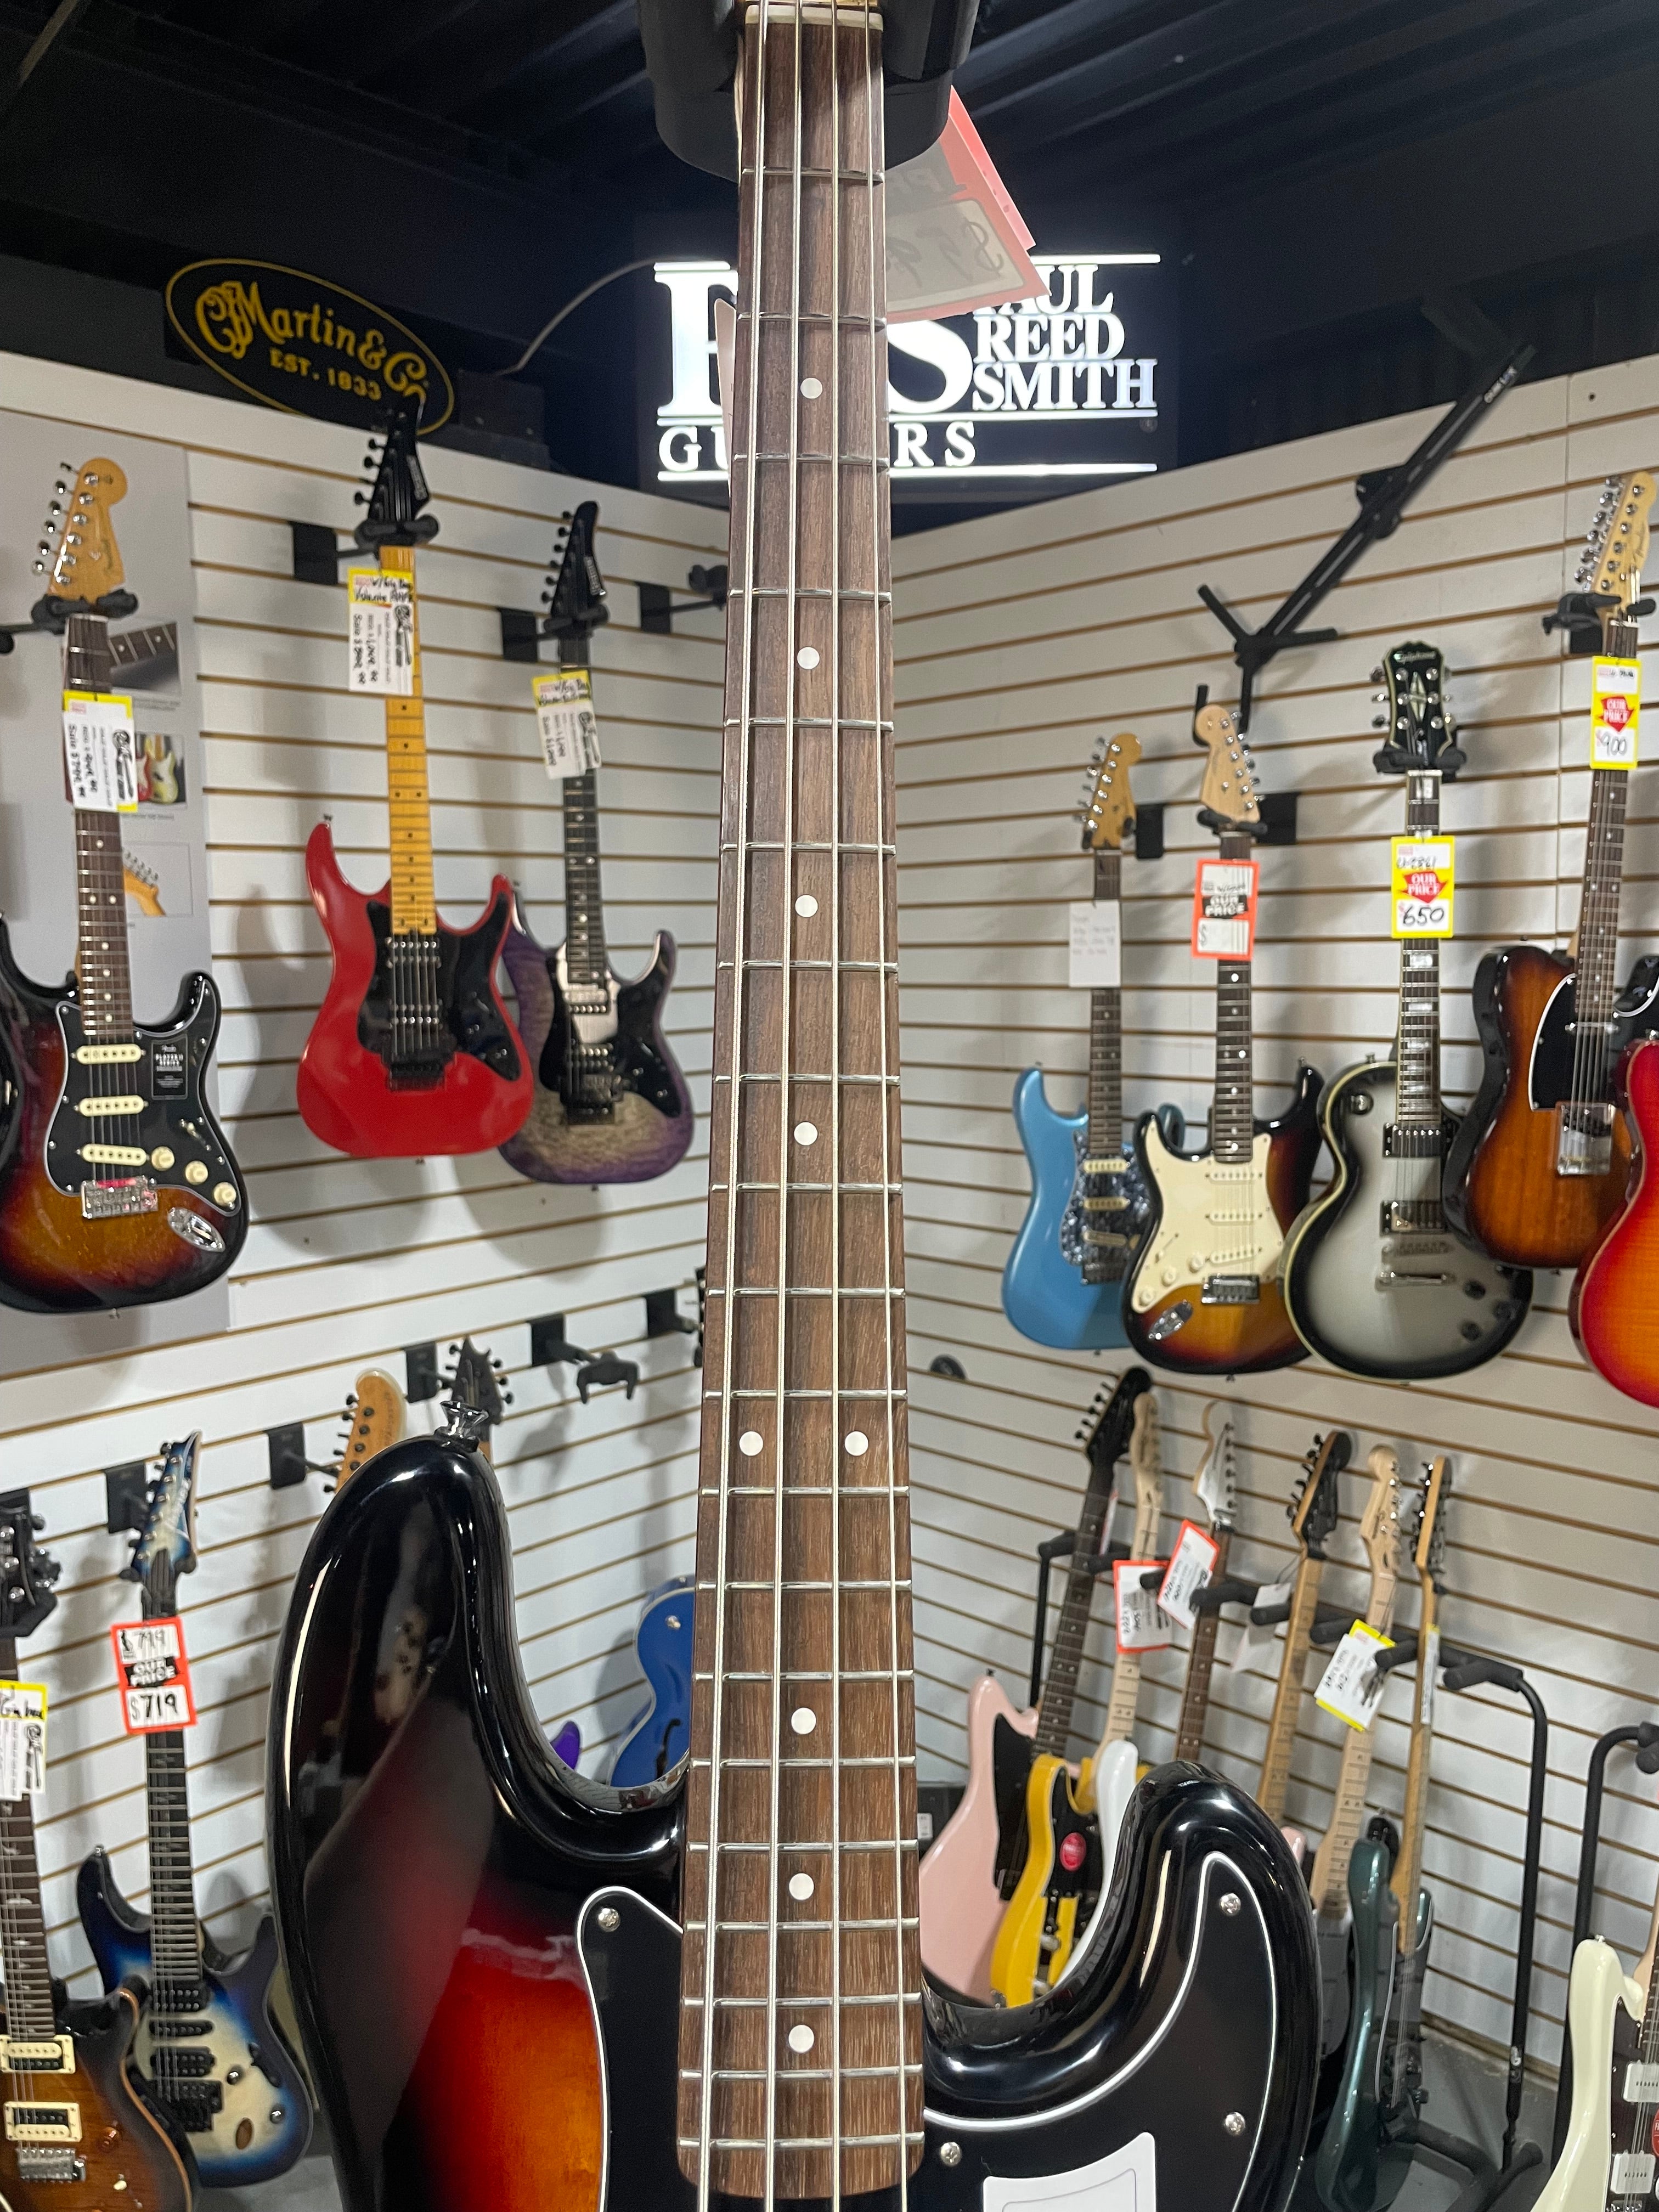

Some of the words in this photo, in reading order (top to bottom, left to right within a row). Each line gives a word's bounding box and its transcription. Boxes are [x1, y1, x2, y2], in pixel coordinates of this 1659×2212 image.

[973, 312, 1125, 363] REED
[972, 358, 1158, 411] SMITH
[1410, 873, 1437, 884] OUR
[1408, 883, 1441, 896] PRICE
[1210, 895, 1239, 906] OUR
[1205, 903, 1245, 917] PRICE
[133, 1659, 165, 1674] OUR
[129, 1666, 176, 1688] PRICE
[129, 1692, 179, 1720] $719
